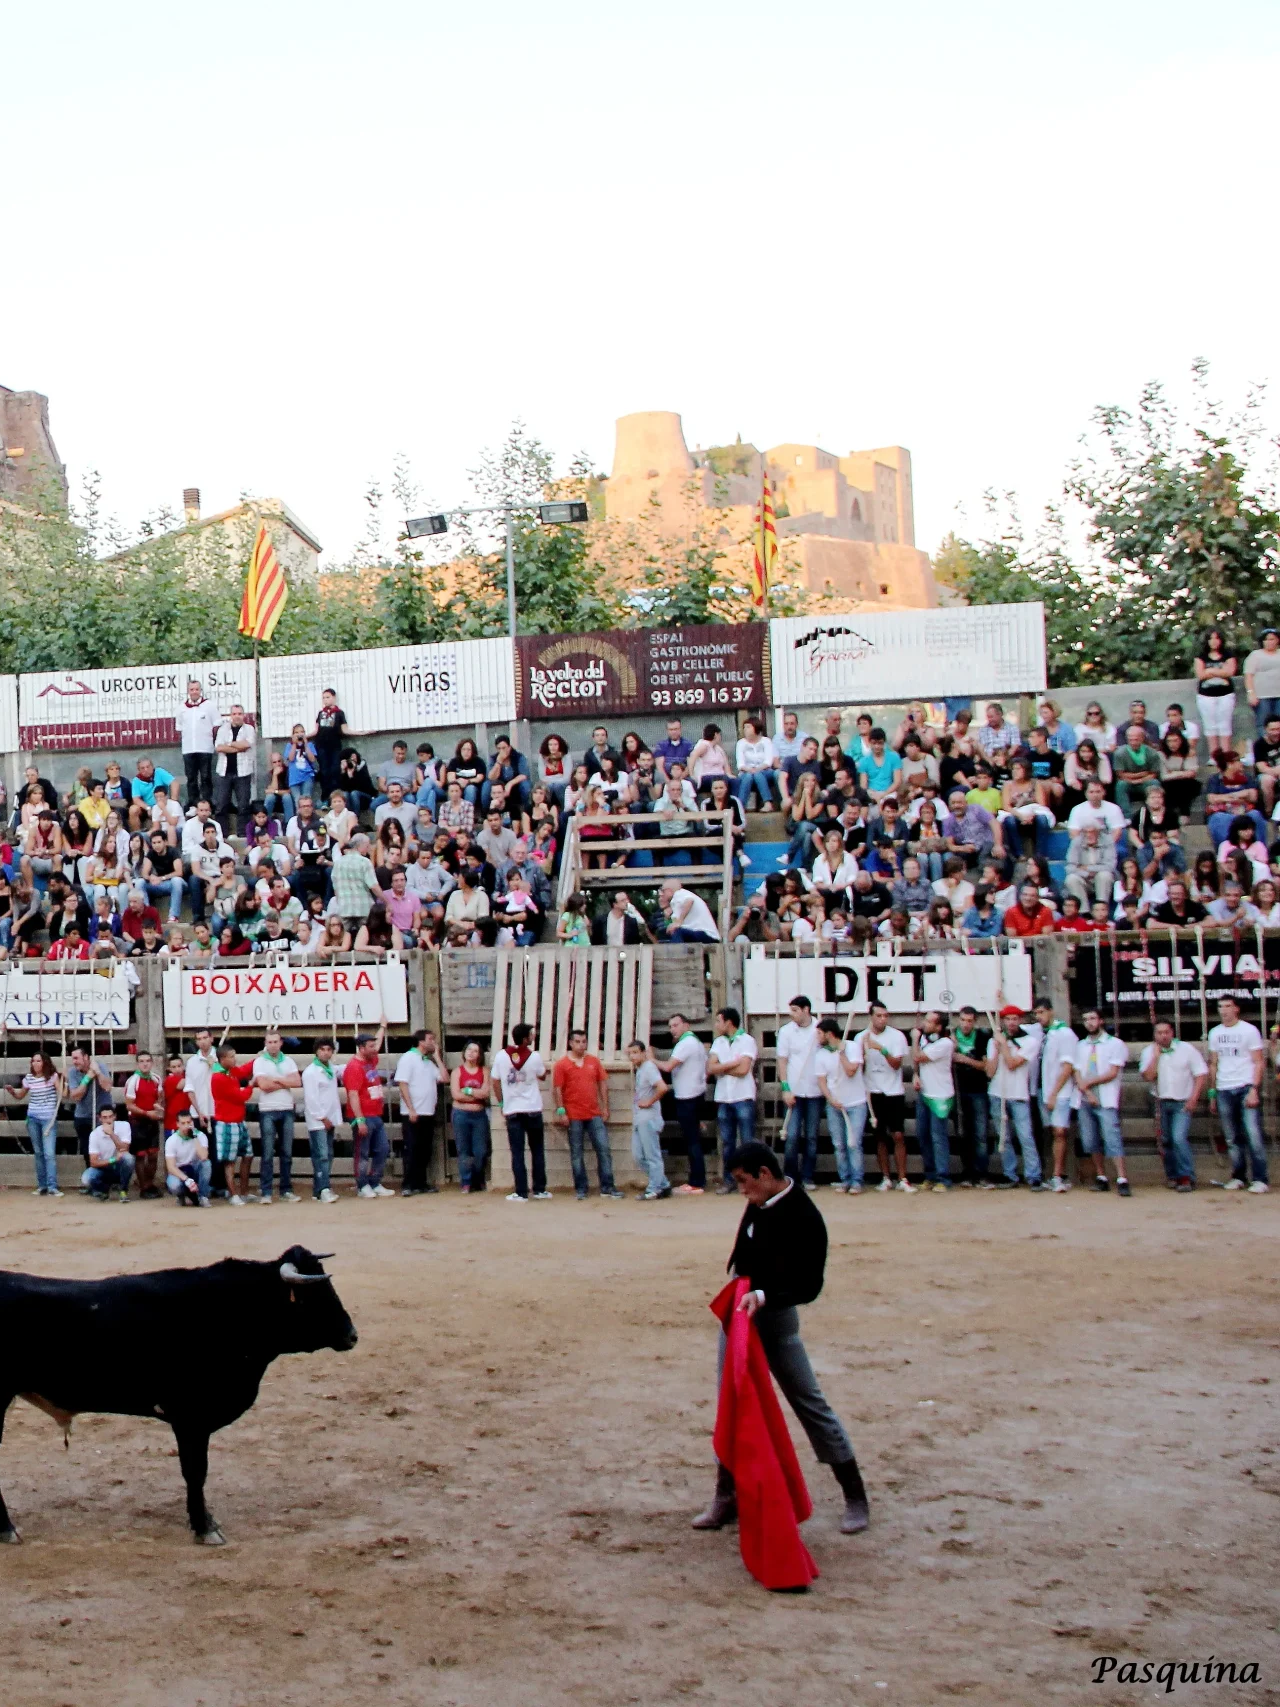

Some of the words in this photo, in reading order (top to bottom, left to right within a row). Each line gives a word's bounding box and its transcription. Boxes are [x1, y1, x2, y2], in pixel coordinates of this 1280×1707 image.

[650, 633, 683, 644] ESPAI
[547, 661, 583, 682] volta
[585, 659, 605, 678] del
[650, 661, 678, 671] AMB
[683, 659, 724, 670] CELLER
[102, 674, 177, 693] URCOTEX
[208, 672, 237, 687] S.L.
[388, 665, 450, 693] viñas
[650, 674, 690, 685] OBERT
[694, 672, 710, 683] AL
[102, 694, 150, 706] EMPRESA
[156, 690, 241, 704] CONSTCTORA
[531, 678, 607, 708] Rector
[651, 691, 671, 705] 93
[675, 690, 703, 705] 869
[709, 688, 729, 703] 16
[732, 687, 753, 701] 37
[1132, 954, 1262, 976] SILVIA
[191, 971, 375, 995] BOIXADERA
[824, 965, 937, 1003] DFT
[206, 1003, 363, 1022] FOTOGRAFIA
